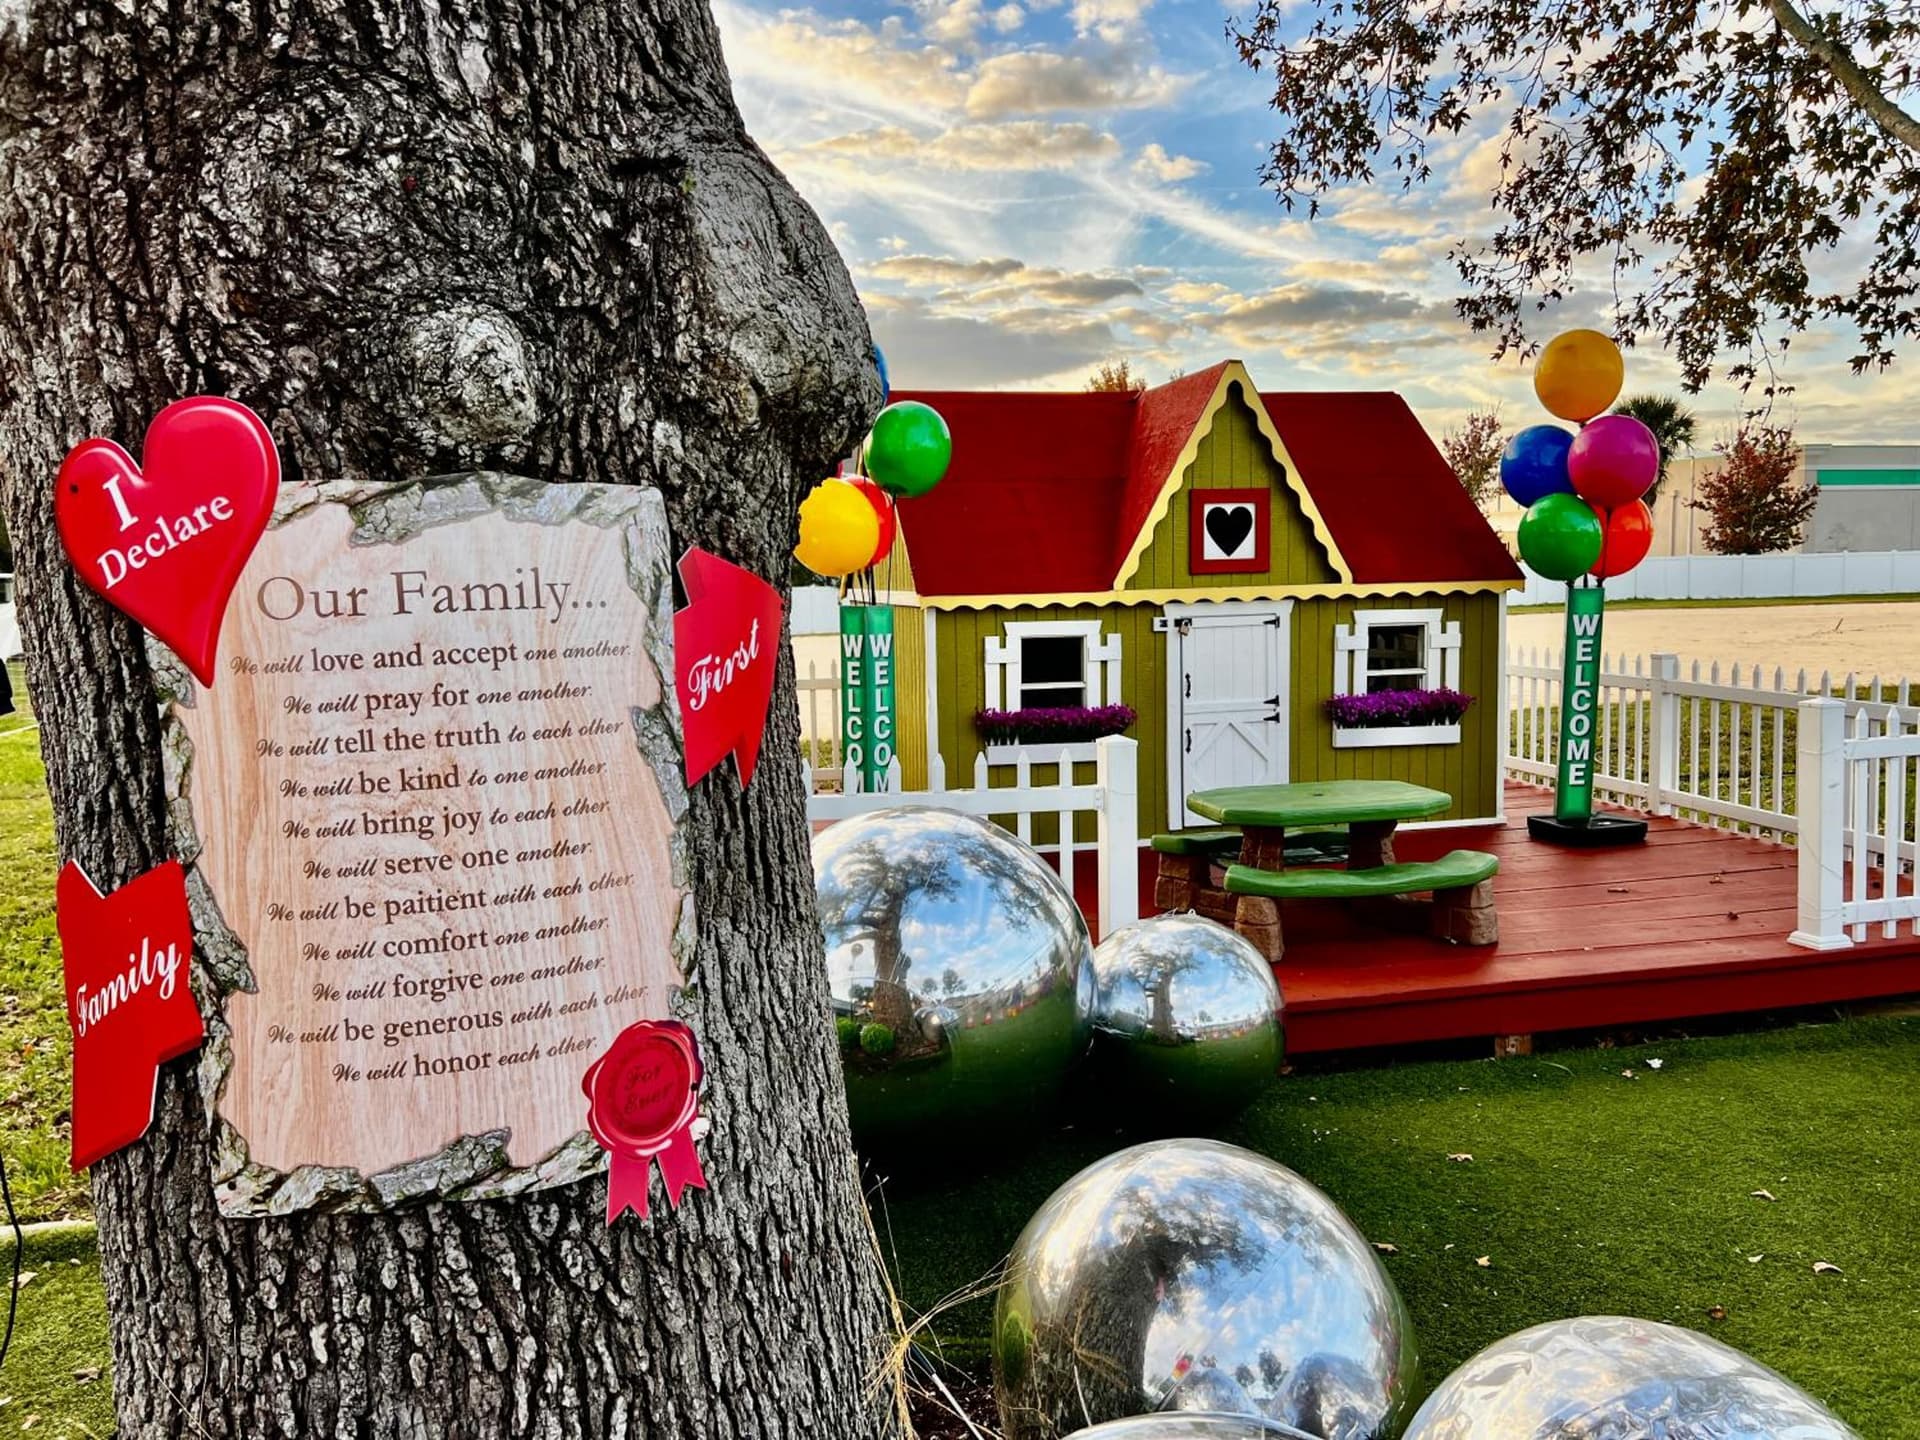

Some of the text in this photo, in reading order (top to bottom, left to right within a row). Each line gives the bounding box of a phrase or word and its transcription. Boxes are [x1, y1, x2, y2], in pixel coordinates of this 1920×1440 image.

[102, 473, 139, 533] I
[96, 494, 236, 590] Declare
[257, 567, 608, 624] Our Family...
[230, 640, 631, 676] We will love and accept one another.
[687, 617, 760, 712] First
[283, 681, 592, 720] We will pray for one another.
[842, 634, 865, 793] WELCO
[869, 634, 892, 793] WELCOM
[1566, 613, 1600, 786] WELCOME
[256, 739, 284, 758] We
[289, 737, 330, 757] will
[335, 728, 376, 754] tell
[384, 727, 426, 751] the
[435, 721, 500, 748] truth
[508, 725, 526, 742] to
[533, 721, 573, 741] each
[280, 758, 607, 798] We will be kind to one another.
[282, 798, 610, 841] We will bring joy to each other.
[303, 839, 592, 880] We will serve one another.
[267, 871, 635, 925] We will be paitient with each other.
[302, 915, 609, 961] We will comfort one another.
[75, 936, 182, 1038] Family
[312, 955, 606, 1003] We will forgive one another.
[268, 983, 649, 1047] We will be generous with each other.
[332, 1035, 598, 1082] We will honor each other.
